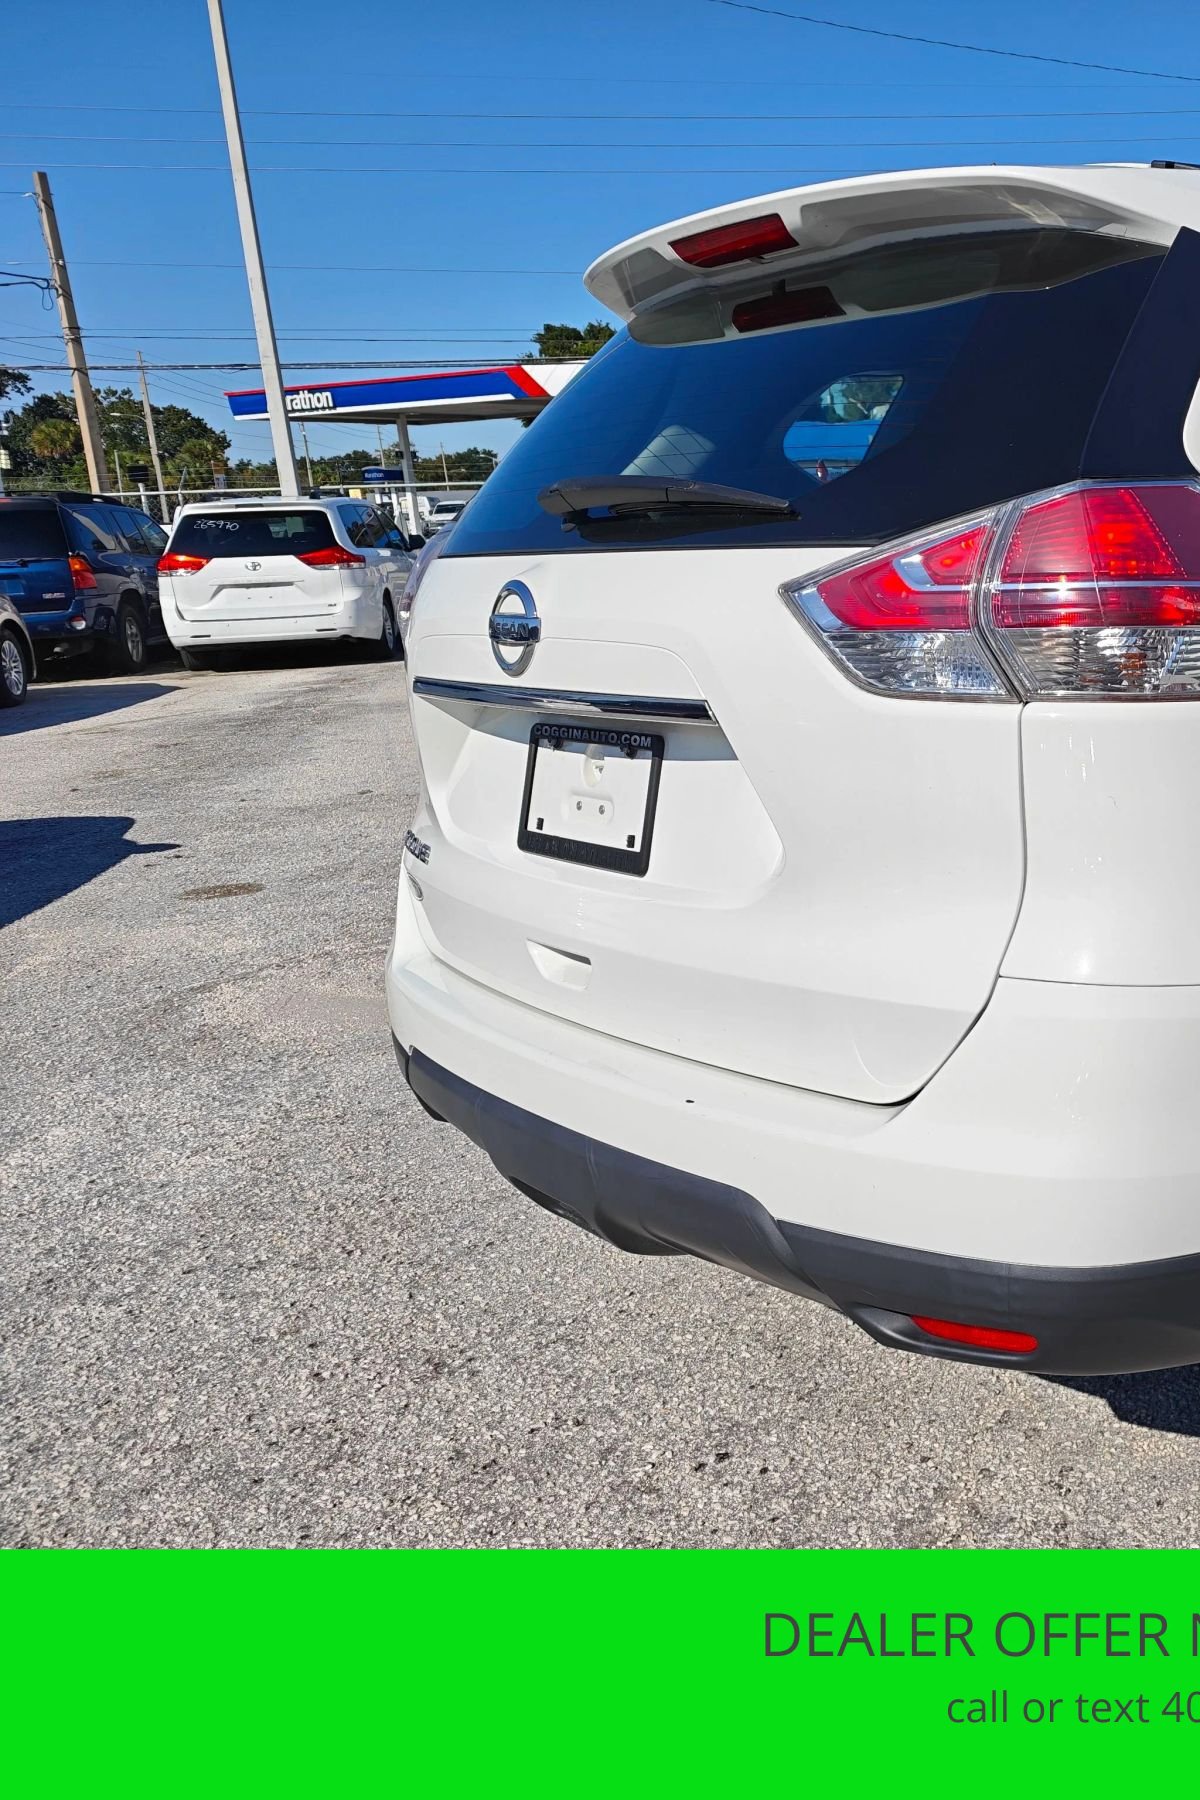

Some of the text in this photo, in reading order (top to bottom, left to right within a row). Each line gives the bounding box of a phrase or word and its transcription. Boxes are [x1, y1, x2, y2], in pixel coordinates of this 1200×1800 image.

[285, 389, 334, 411] rathon
[193, 518, 240, 531] 265970
[534, 724, 652, 748] COGGINAUTO.COM
